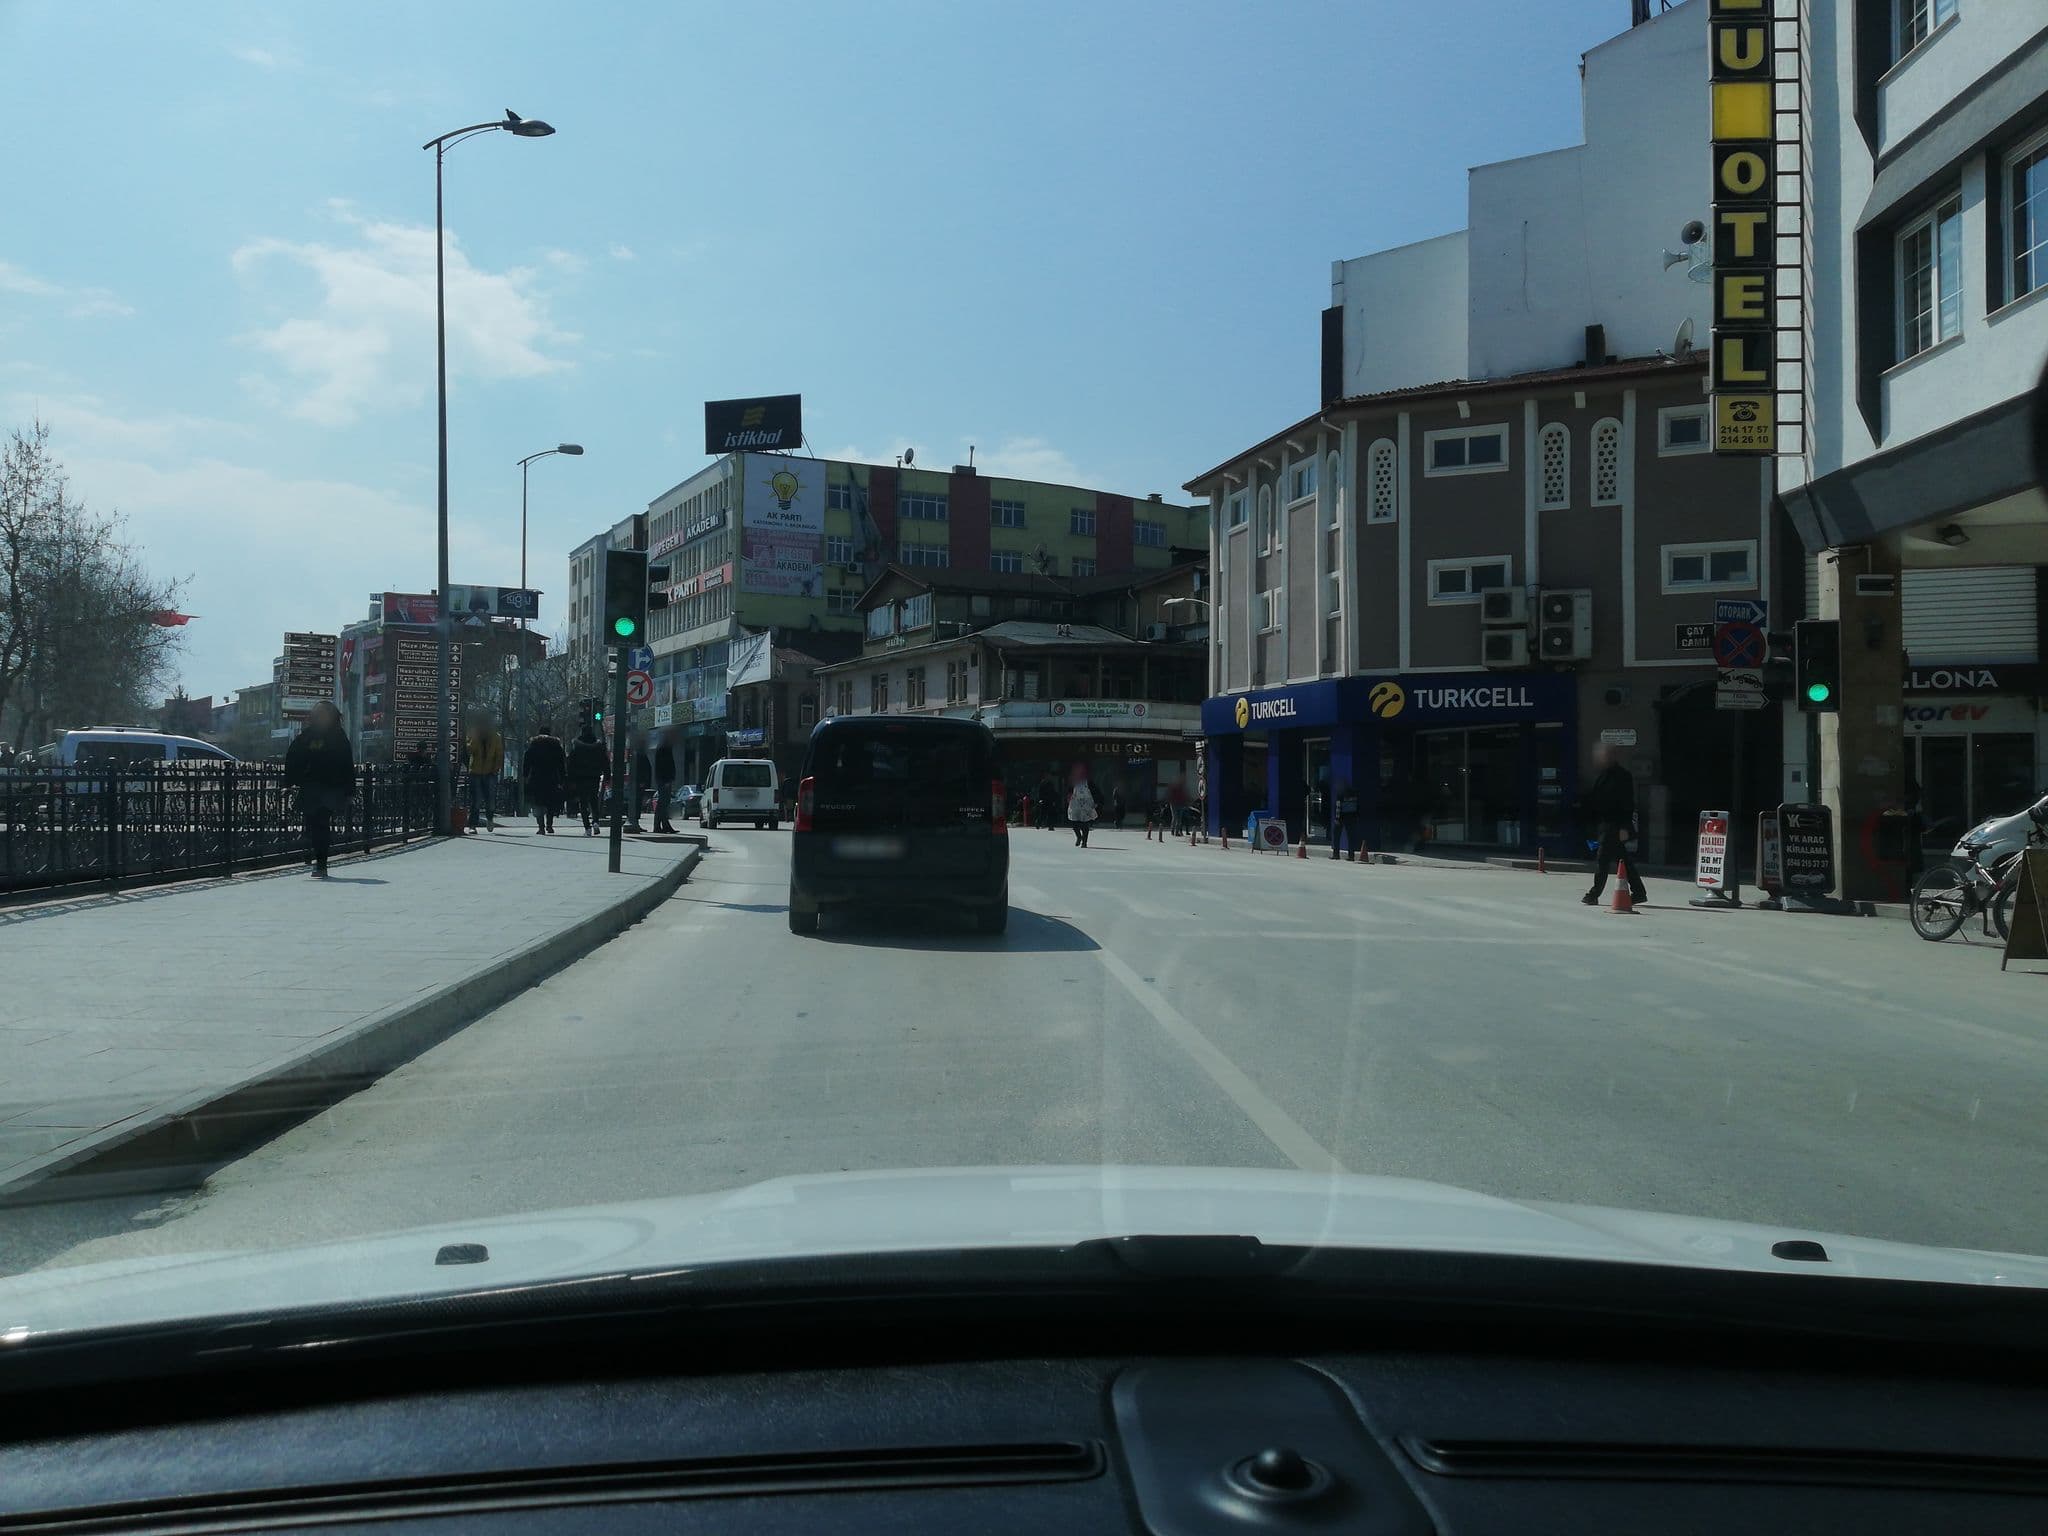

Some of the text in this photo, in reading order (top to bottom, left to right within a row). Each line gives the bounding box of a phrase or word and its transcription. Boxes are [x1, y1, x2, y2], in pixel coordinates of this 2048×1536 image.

[1720, 151, 1767, 382] OTEL
[1720, 425, 1768, 434] 214 17 57
[724, 428, 783, 448] istikbal
[1720, 435, 1739, 444] 214
[1757, 435, 1768, 444] 10
[768, 510, 780, 520] AK
[1718, 605, 1752, 621] OTOPARK
[1686, 627, 1705, 638] ÇAY
[1412, 687, 1534, 711] TURKCELL
[1251, 698, 1297, 720] TURKCELL
[1786, 844, 1828, 855] KİRALAMA
[1701, 856, 1722, 865] 50 MT
